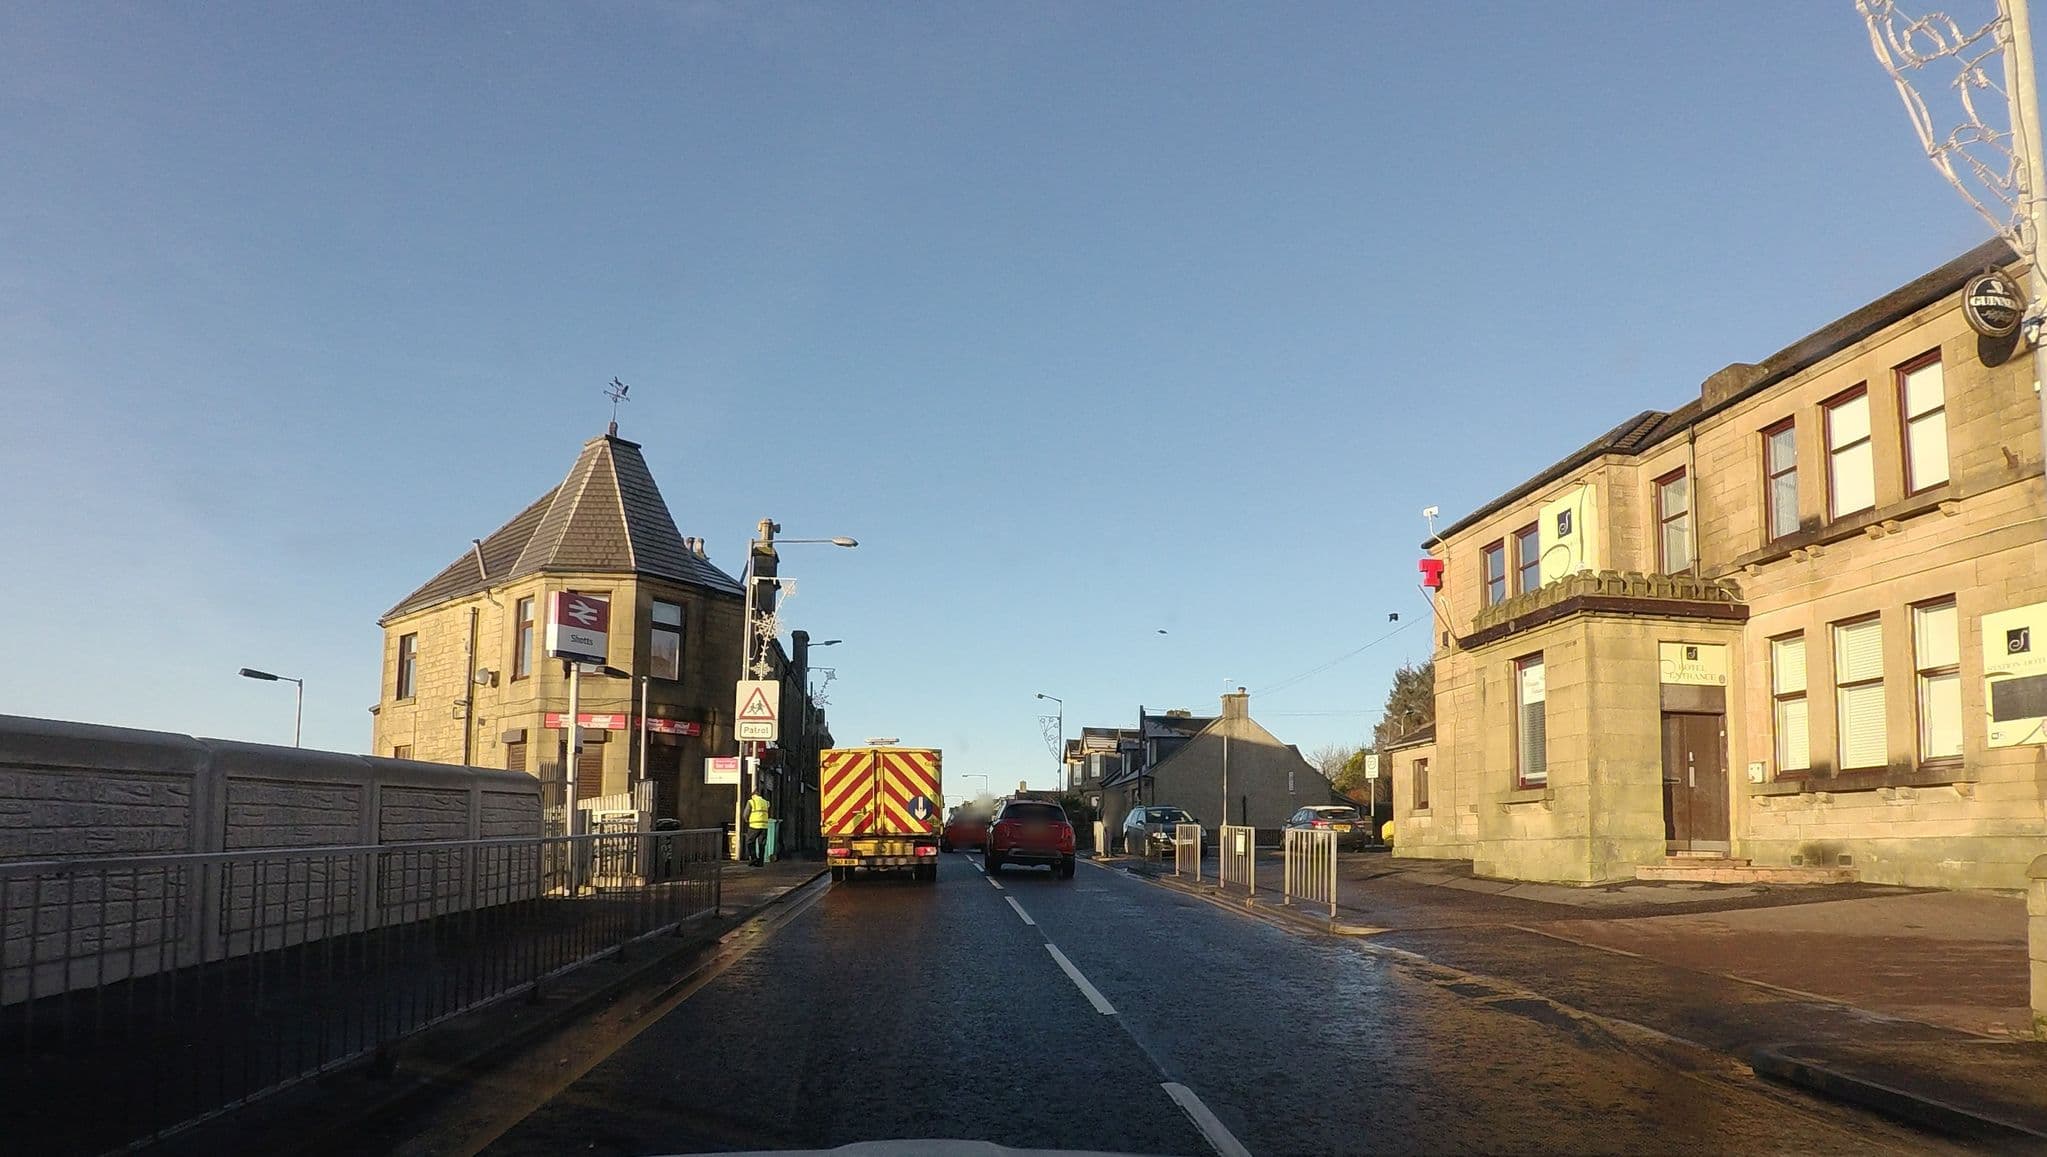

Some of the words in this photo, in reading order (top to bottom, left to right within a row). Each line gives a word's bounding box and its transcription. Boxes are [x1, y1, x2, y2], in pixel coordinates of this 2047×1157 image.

[570, 634, 594, 646] Shotts
[1678, 663, 1704, 672] HOTEL
[1668, 672, 1717, 681] ENTRANCE
[743, 726, 769, 734] Patrol
